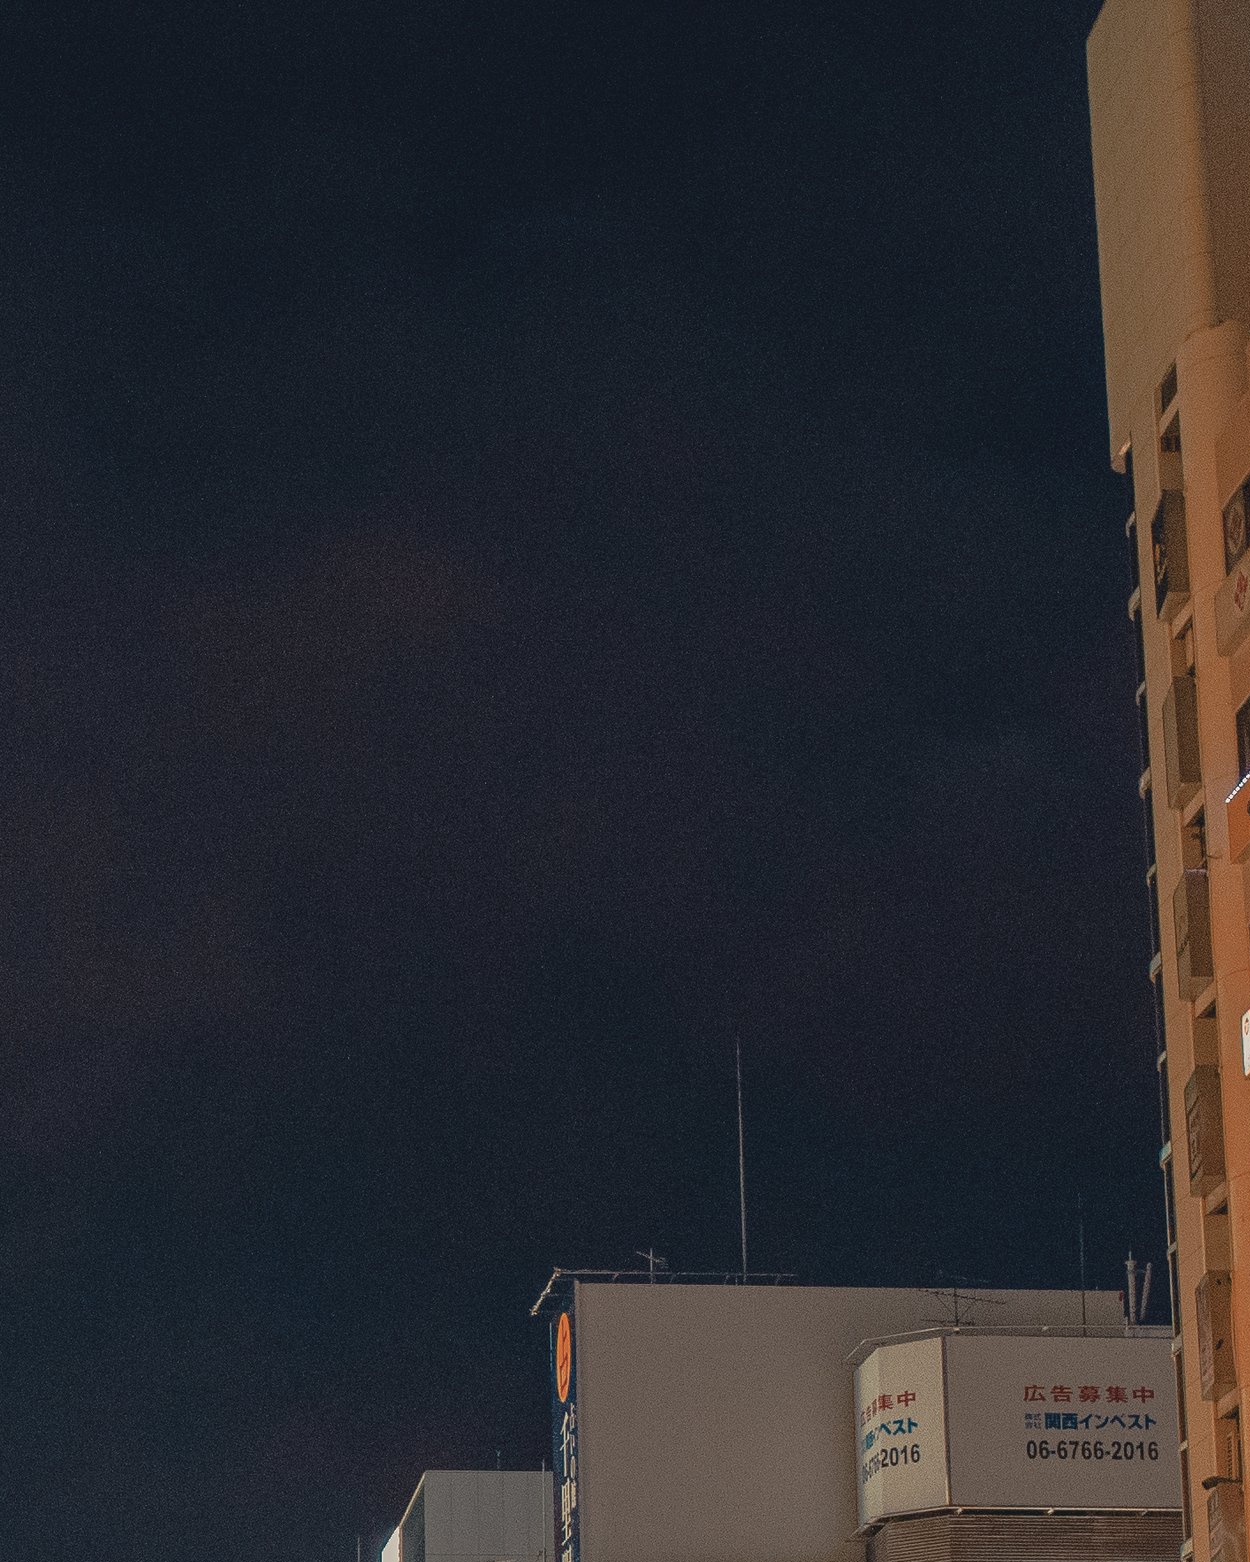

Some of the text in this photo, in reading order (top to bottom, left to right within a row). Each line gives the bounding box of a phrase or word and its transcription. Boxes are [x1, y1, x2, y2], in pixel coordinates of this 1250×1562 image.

[1024, 1384, 1155, 1404] 広告募集中
[1044, 1412, 1157, 1431] 関西インベスト
[1026, 1440, 1159, 1461] 06-6766-2016
